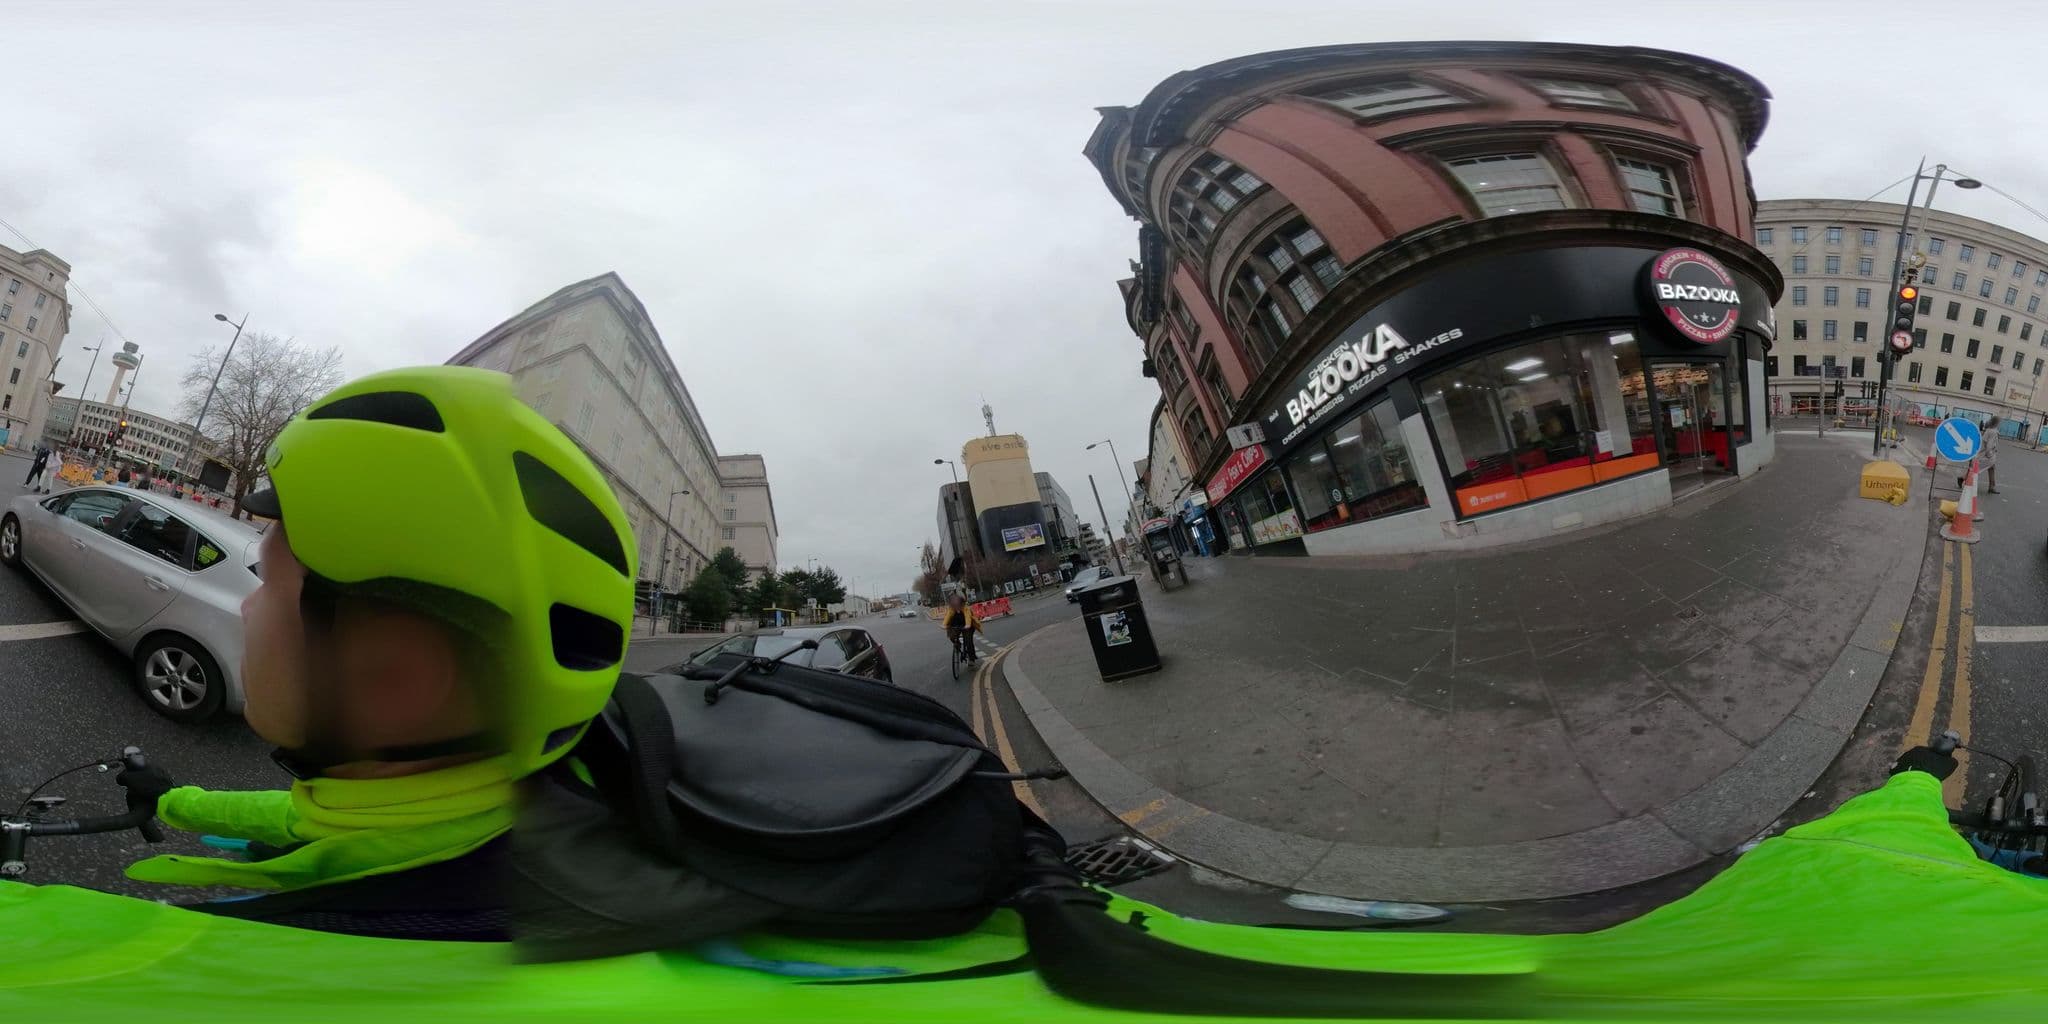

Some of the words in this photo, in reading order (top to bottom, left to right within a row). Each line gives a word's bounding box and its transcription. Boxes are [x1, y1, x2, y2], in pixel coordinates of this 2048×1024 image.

[1658, 252, 1690, 274] CHICKEN
[1656, 283, 1741, 305] BAZOOKA
[1678, 318, 1708, 339] PIZZAS
[1712, 318, 1735, 340] SHAKES
[1285, 322, 1412, 426] BAZOOKA
[1308, 341, 1351, 381] CHICKEN
[1281, 422, 1307, 446] CHICKEN
[1308, 394, 1345, 425] BURGERS
[1349, 364, 1388, 395] PIZZAS
[1394, 328, 1464, 365] SHAKES
